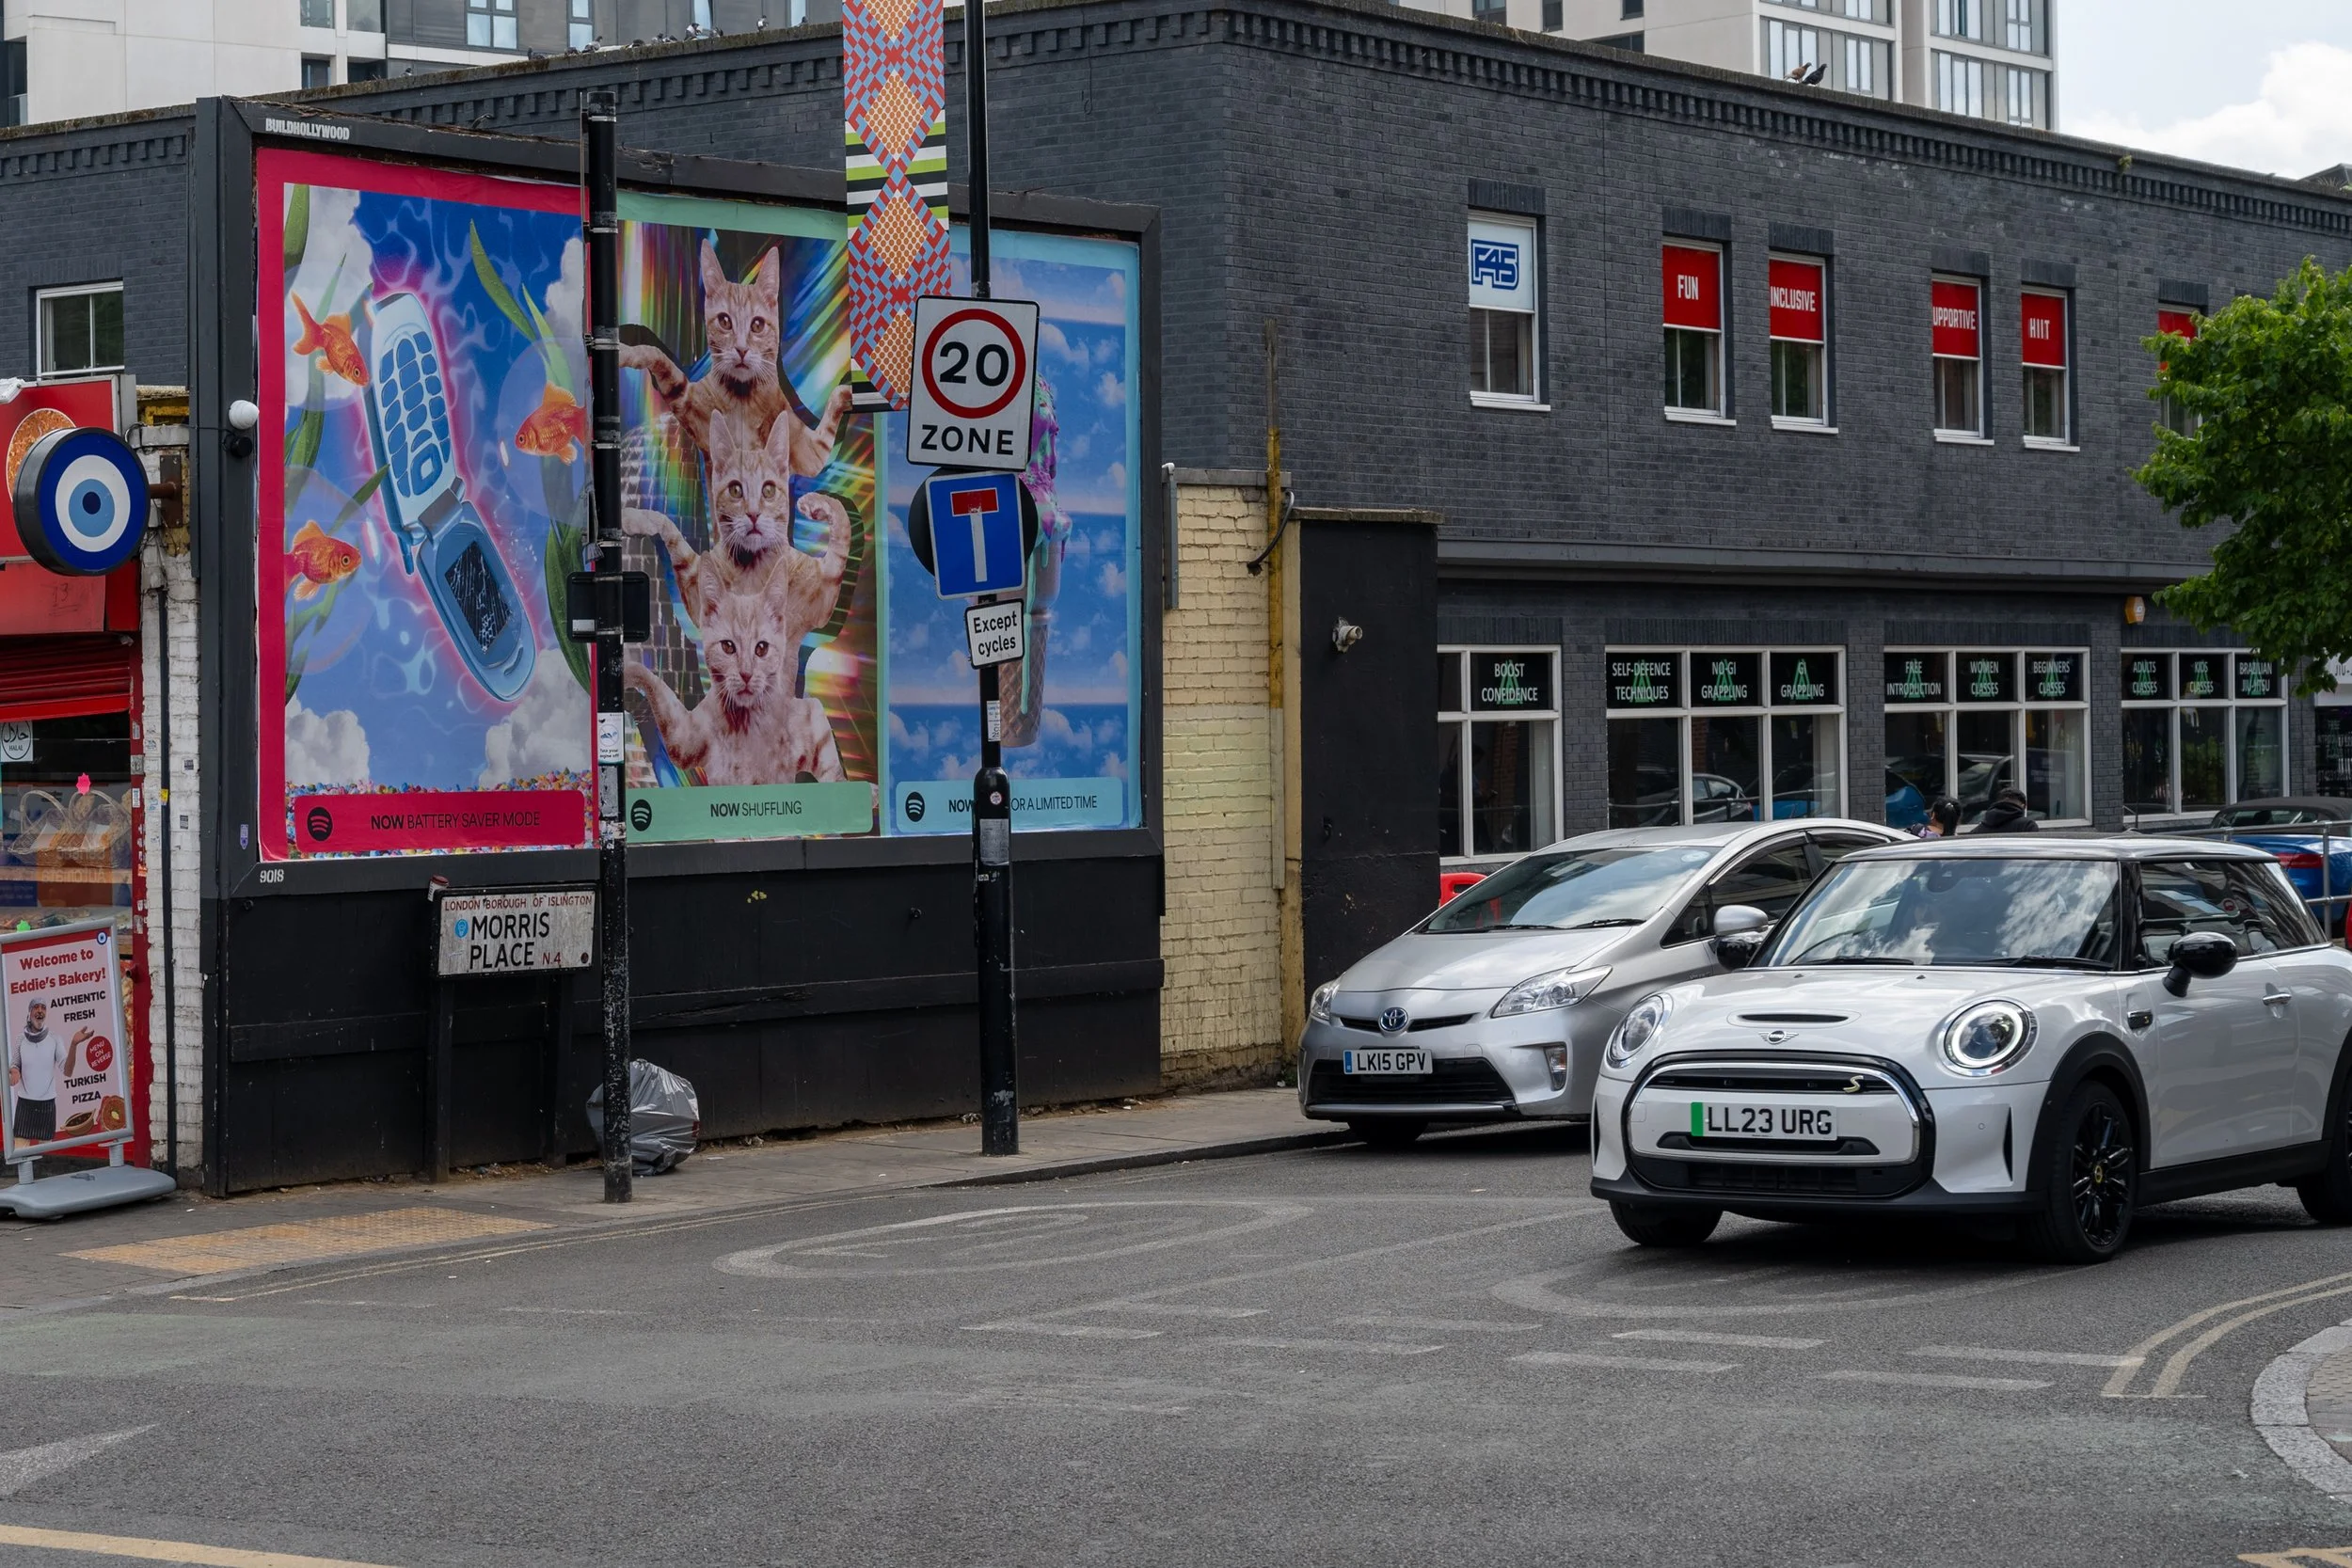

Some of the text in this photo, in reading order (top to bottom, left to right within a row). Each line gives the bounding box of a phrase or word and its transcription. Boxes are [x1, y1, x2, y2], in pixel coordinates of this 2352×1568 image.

[265, 118, 350, 140] BUILDHOLLYWOOD
[1471, 239, 1519, 290] F45
[1677, 274, 1699, 300] FUN
[1770, 286, 1816, 311] INCLUSIVE
[1932, 306, 1976, 329] UPPORTIVE
[2029, 317, 2050, 340] HIIT
[939, 341, 1009, 387] 20
[920, 424, 1014, 455] ZONE
[973, 610, 1018, 634] Except
[977, 635, 1016, 657] cycles
[1494, 663, 1525, 677] BOOST
[1612, 662, 1671, 676] SELF-DEFENCE
[1711, 661, 1737, 675] NO-GI
[1798, 661, 1807, 675] GI
[1905, 661, 1923, 673] FREE
[1970, 661, 1999, 673] WOMEN
[2033, 660, 2071, 673] BEGINNERS
[2132, 660, 2156, 673] ADULTS
[2194, 661, 2209, 673] KIDS
[2239, 661, 2273, 675] BRAZILIAN
[1481, 687, 1538, 702] CONFIDENCE
[1615, 686, 1669, 701] TECHNIQUES
[1701, 684, 1748, 699] GRAPPLING
[1780, 684, 1824, 698] GRAPPLING
[1886, 682, 1942, 695] INTRODUCTION
[1971, 682, 1999, 695] CLASSES
[2039, 682, 2066, 694] CLASSES
[2132, 681, 2157, 694] CLASSES
[2189, 681, 2215, 693] CLASSES
[710, 800, 803, 817] NOW SHUFFLING
[1010, 798, 1025, 812] OR
[1026, 798, 1035, 811] A
[1036, 796, 1073, 811] LIMITED
[1073, 795, 1098, 809] TIME
[371, 811, 541, 830] NOW BATTERY SAVER MODE
[444, 895, 593, 911] LONDON BOROUGH OF ISLINGTON
[471, 911, 550, 941] MORRIS
[20, 948, 94, 971] Welcome to
[470, 942, 535, 970] PLACE
[10, 967, 106, 994] Eddie's Bakery!
[50, 990, 106, 1008] AUTHENTIC
[64, 1008, 96, 1022] FRESH
[89, 1040, 105, 1053] MENU
[95, 1049, 104, 1058] ON
[90, 1052, 112, 1069] REVERSE
[1357, 1053, 1426, 1071] LK15 GPV
[64, 1072, 107, 1089] TURKISH
[72, 1090, 102, 1104] PIZZA
[1708, 1106, 1832, 1135] LL23 URG
